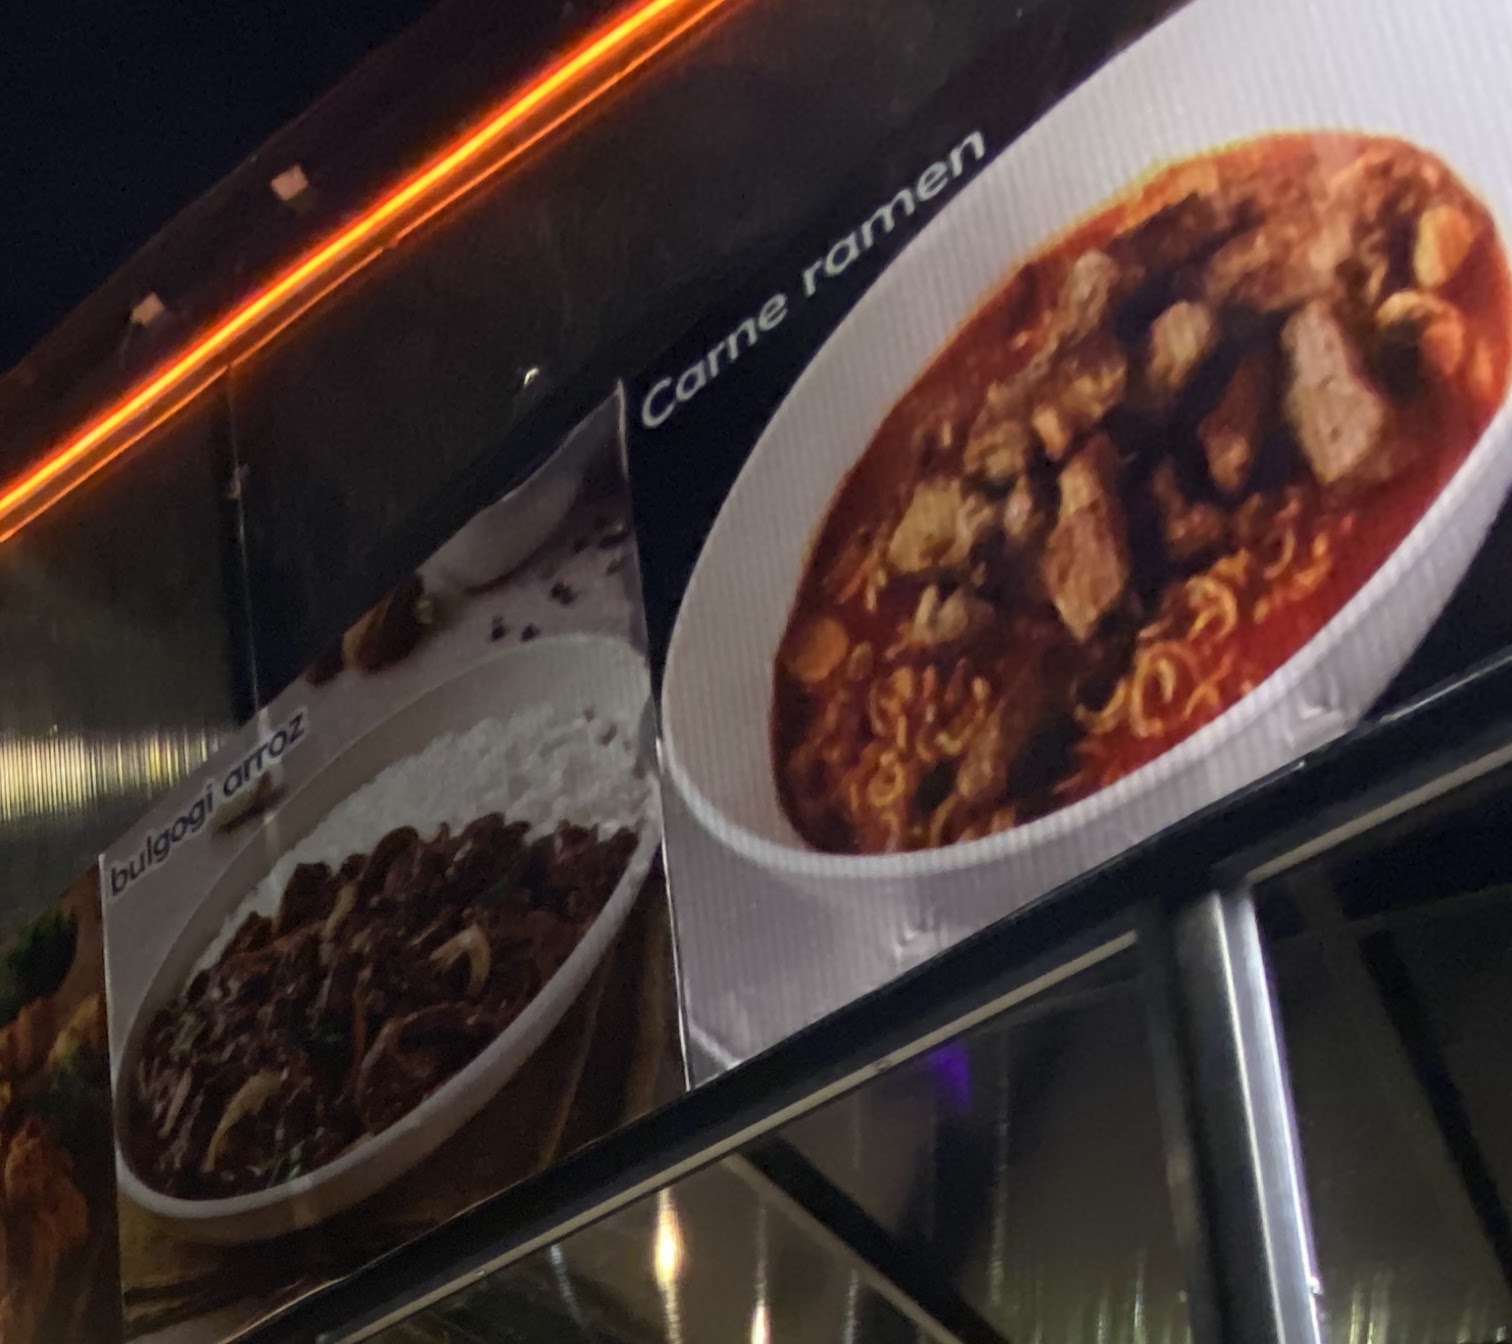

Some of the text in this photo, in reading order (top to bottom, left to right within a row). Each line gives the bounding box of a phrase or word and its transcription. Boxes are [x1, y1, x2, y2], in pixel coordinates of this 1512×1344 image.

[641, 129, 986, 429] Carne ramen
[110, 711, 305, 897] bulgogi arroz
